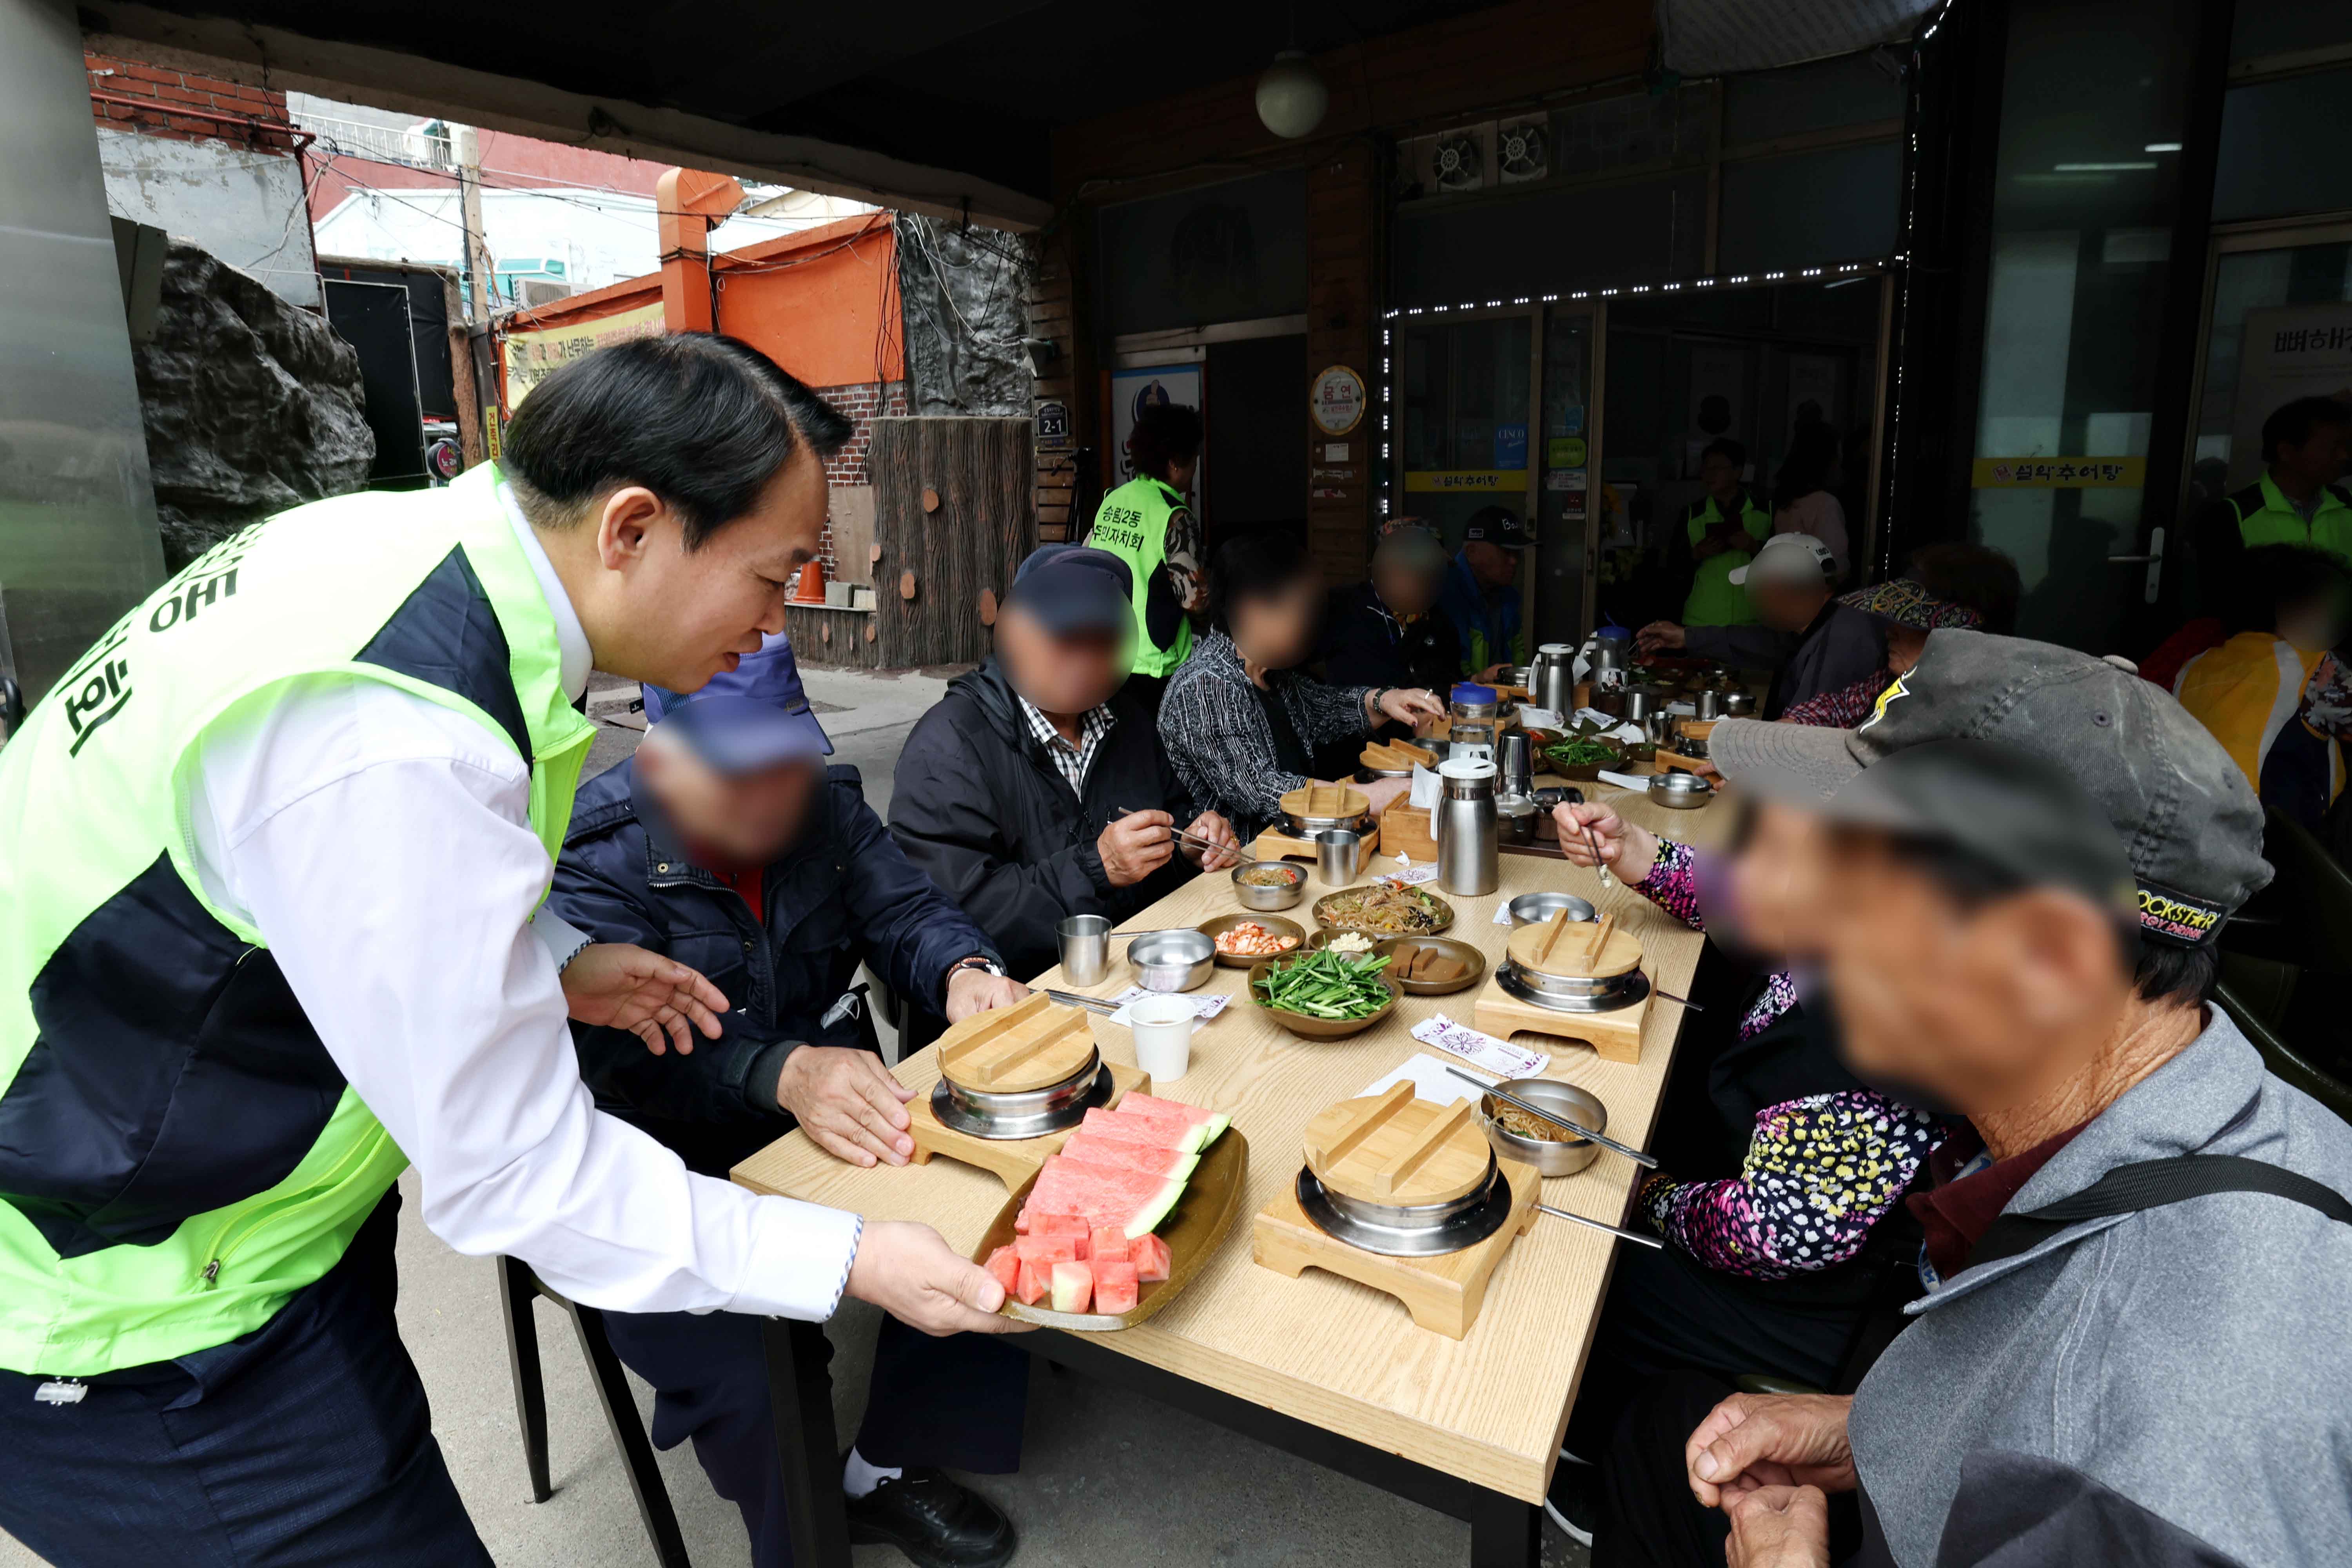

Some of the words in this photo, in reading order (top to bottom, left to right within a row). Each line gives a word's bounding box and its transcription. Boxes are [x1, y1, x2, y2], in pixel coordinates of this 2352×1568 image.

[1044, 419, 1062, 433] 2-1
[1102, 505, 1142, 528] 송림2동
[1092, 524, 1145, 552] 주민자치회
[2138, 890, 2219, 929] OCKSTAR
